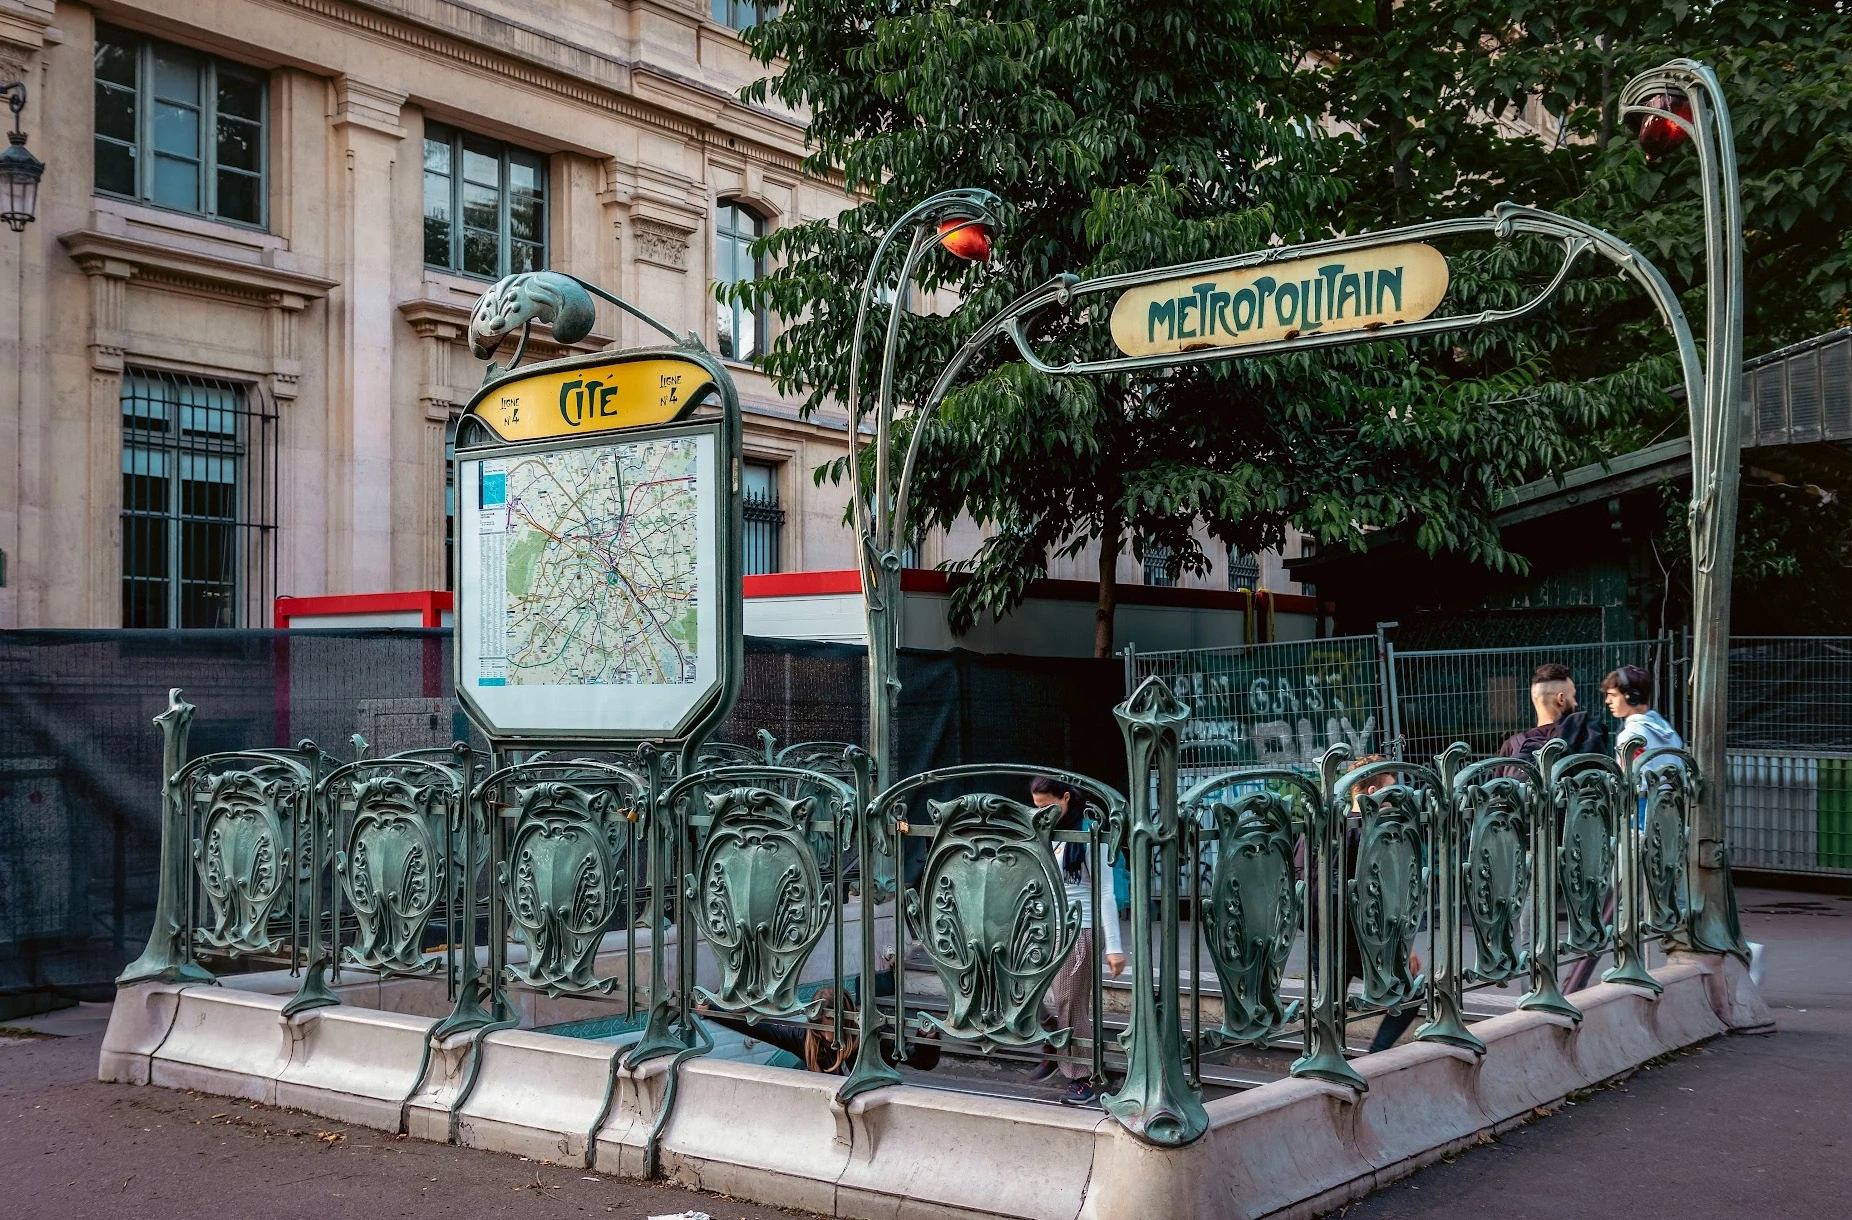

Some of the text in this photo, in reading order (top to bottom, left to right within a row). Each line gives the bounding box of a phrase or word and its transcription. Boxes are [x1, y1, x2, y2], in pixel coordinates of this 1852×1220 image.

[1148, 264, 1404, 343] METROPOLITAIN
[660, 374, 682, 388] LIGNE
[500, 397, 520, 411] LIGNE
[559, 374, 619, 427] CITÉ
